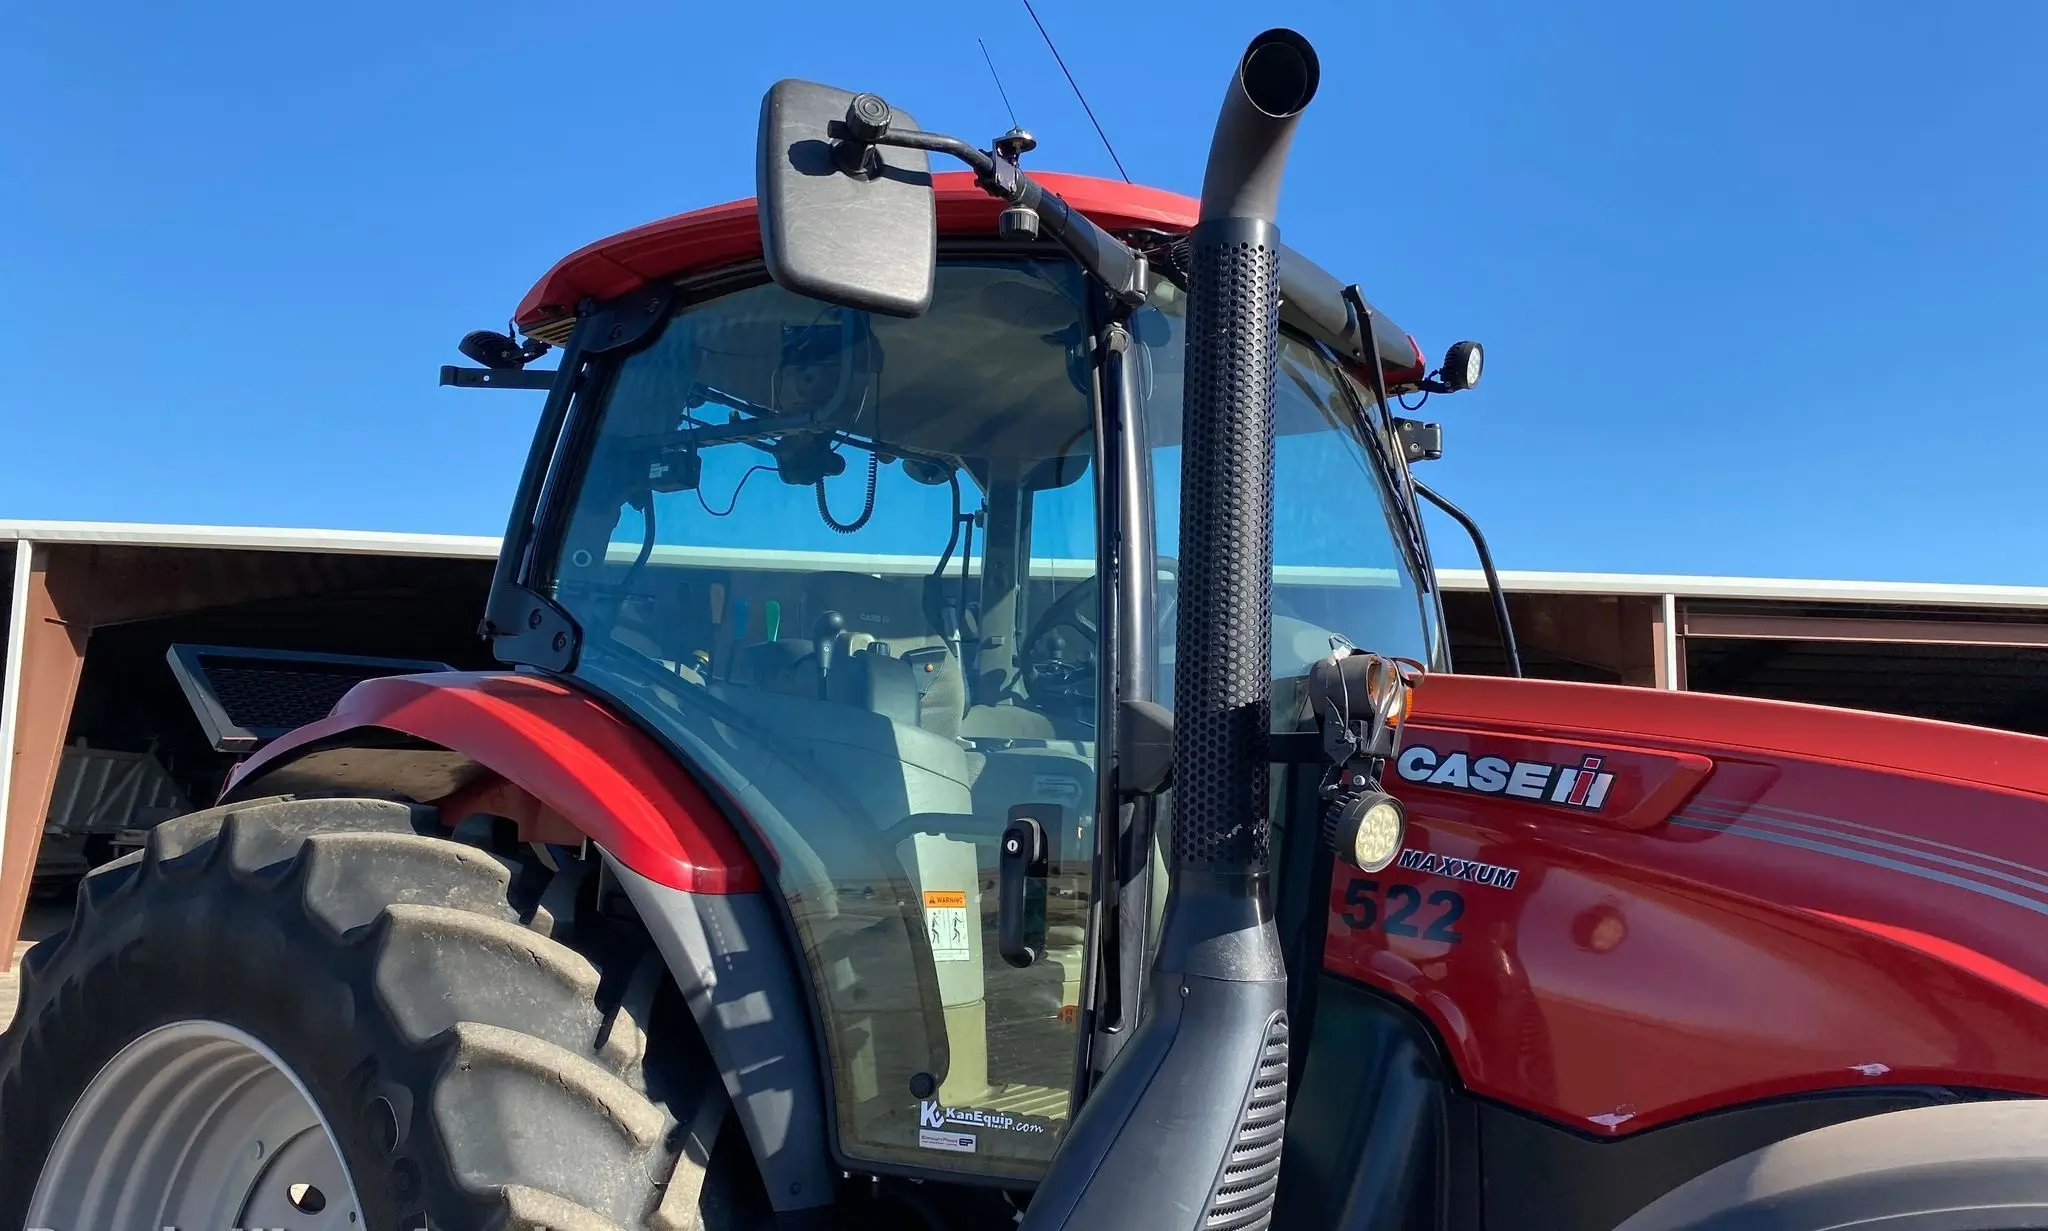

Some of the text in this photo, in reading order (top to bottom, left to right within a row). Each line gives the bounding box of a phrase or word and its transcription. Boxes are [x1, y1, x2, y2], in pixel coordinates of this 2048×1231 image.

[1397, 746, 1553, 799] CASE
[1398, 848, 1520, 890] MAXXUM
[936, 896, 963, 904] WARNING
[1341, 877, 1466, 944] 522
